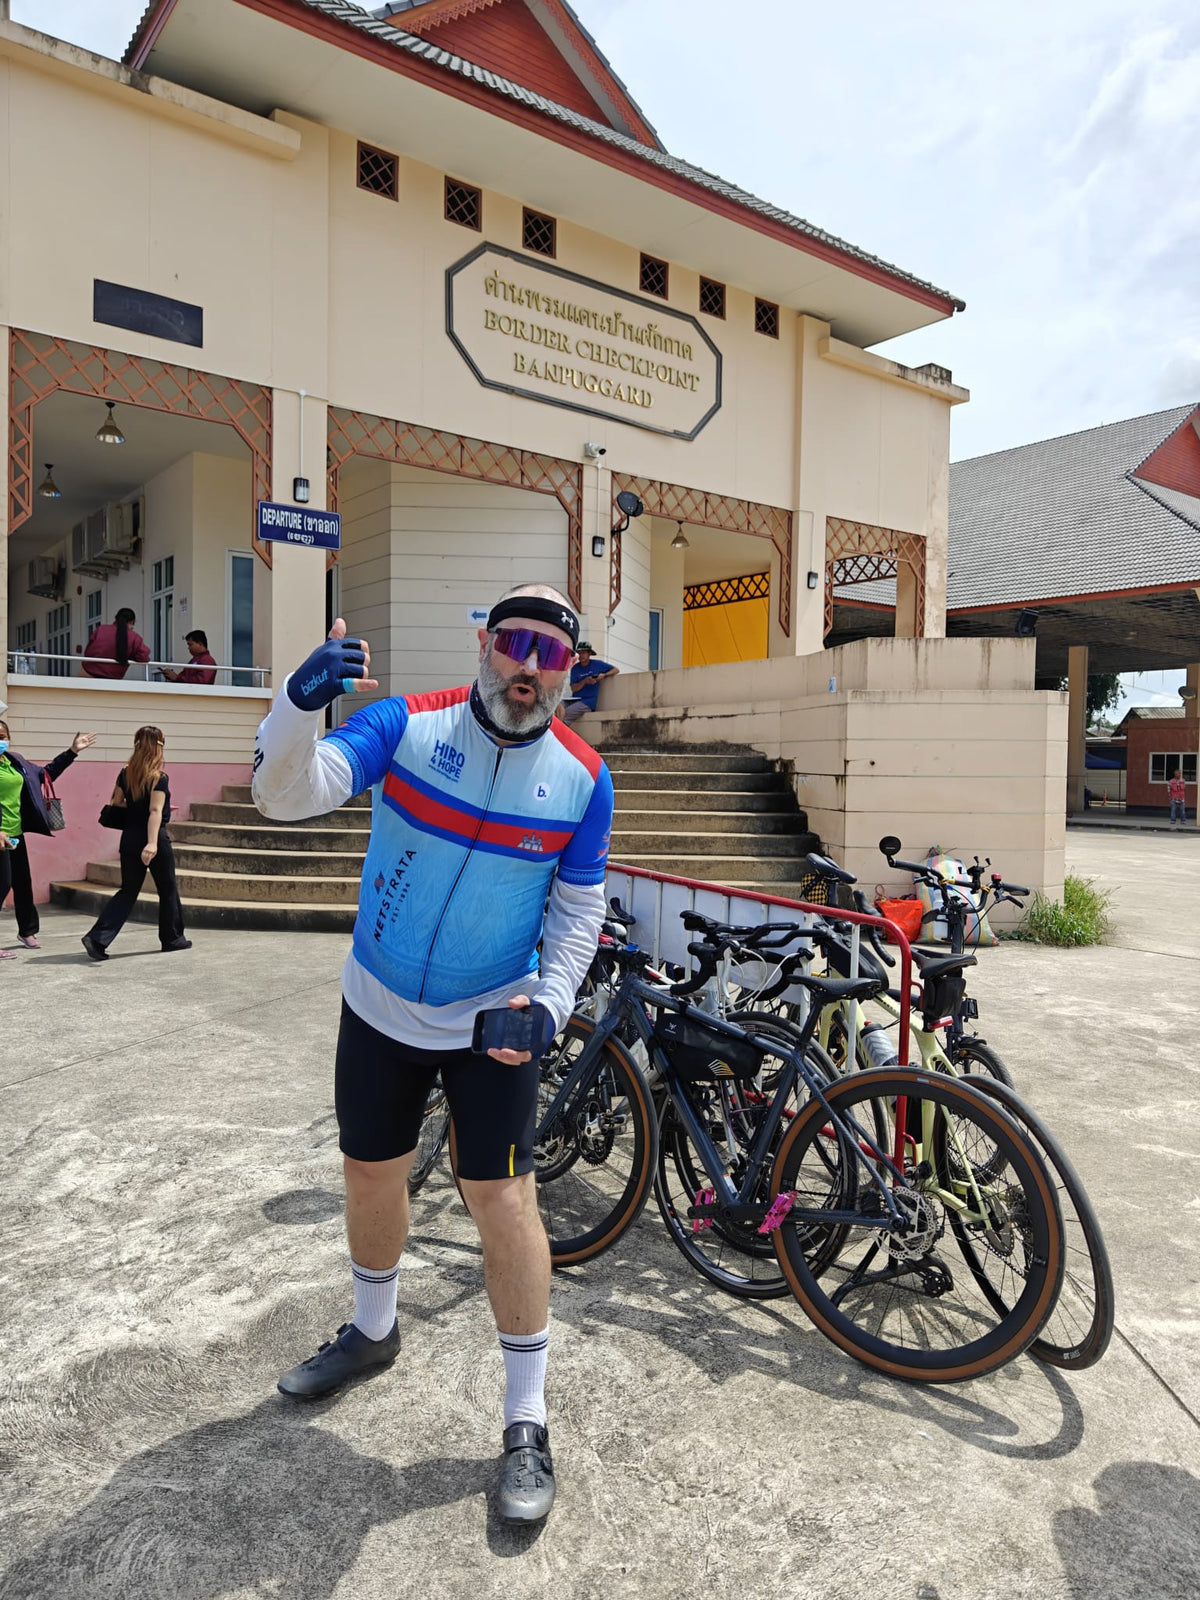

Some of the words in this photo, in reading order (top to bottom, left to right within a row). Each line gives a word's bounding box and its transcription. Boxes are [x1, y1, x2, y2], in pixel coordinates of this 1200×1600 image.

[484, 309, 572, 354] BORDER
[576, 339, 700, 392] CHECKPOINT
[513, 352, 654, 408] BANPUGGARD
[262, 507, 302, 530] DEPARTURE
[303, 514, 339, 536] (ขาออก)
[301, 668, 329, 697] bizkut
[430, 754, 437, 765] 4
[437, 758, 462, 779] HOPE
[434, 739, 465, 768] HIRO
[374, 850, 417, 942] NETSTRATA
